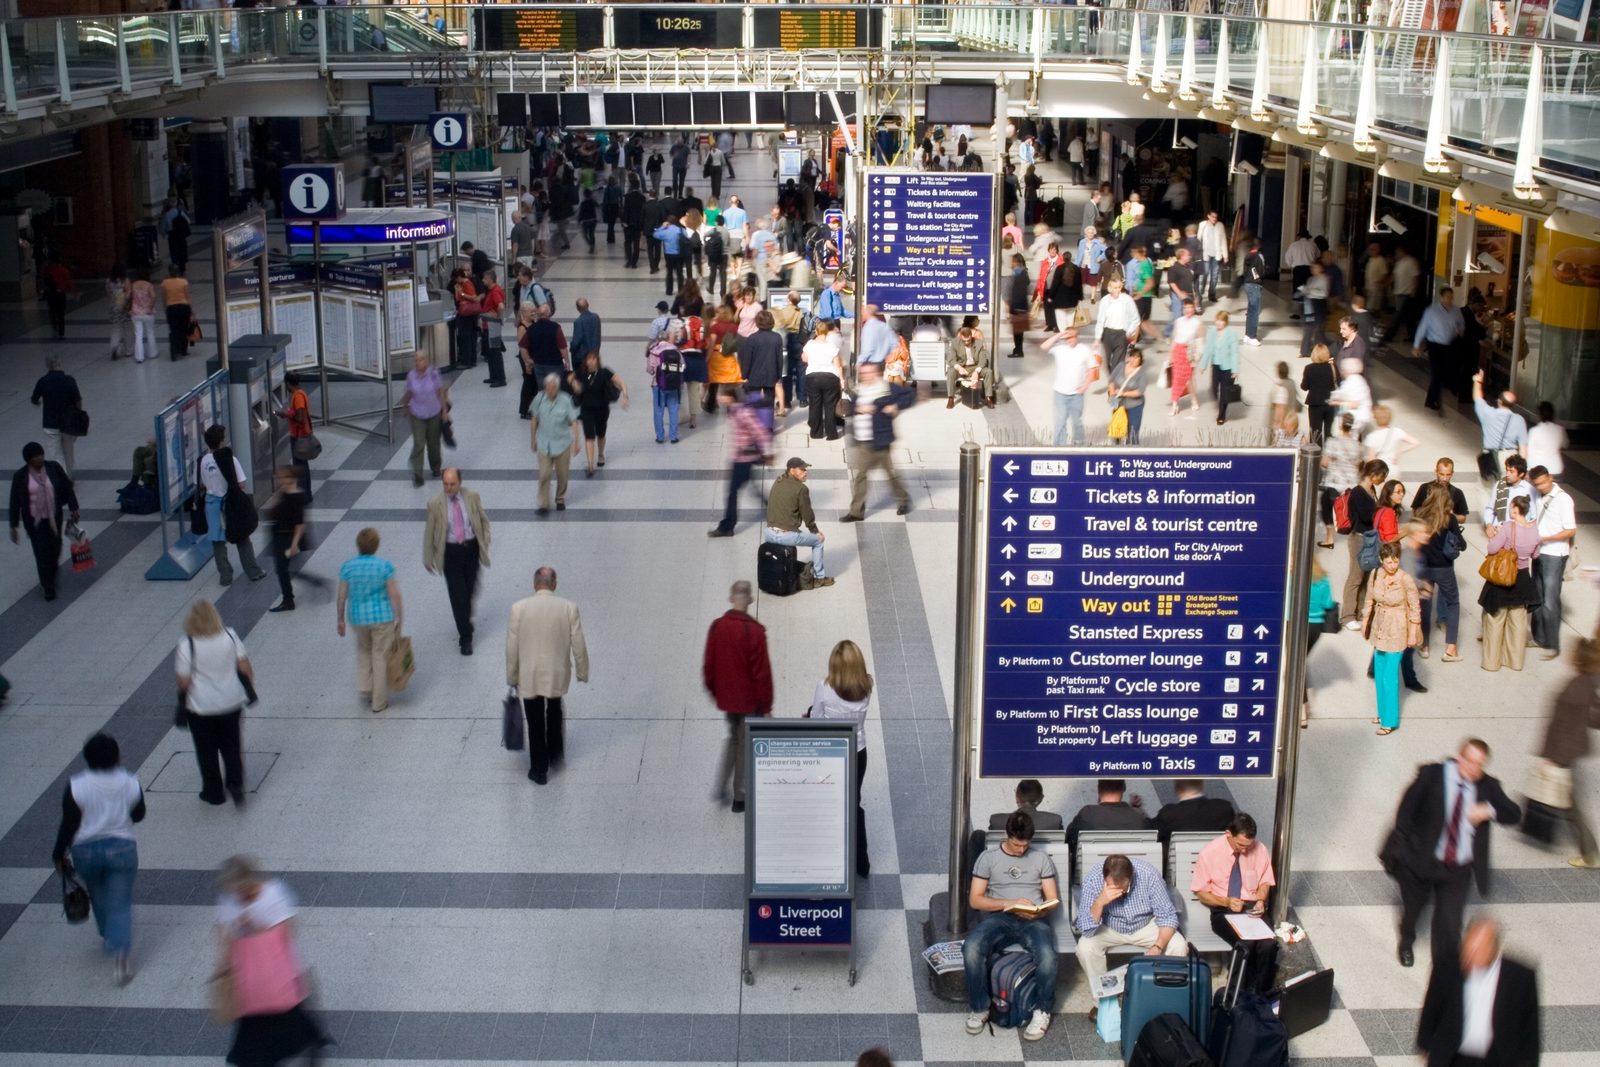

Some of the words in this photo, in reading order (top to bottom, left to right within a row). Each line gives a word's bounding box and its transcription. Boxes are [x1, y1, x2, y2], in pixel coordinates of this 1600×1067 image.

[386, 224, 446, 239] information
[906, 235, 949, 243] Underground
[1086, 461, 1113, 475] Lift
[1120, 459, 1130, 468] To
[1133, 460, 1152, 471] Way
[1154, 461, 1171, 471] out,
[1173, 460, 1232, 472] Underground
[1119, 469, 1135, 477] and
[1138, 469, 1154, 478] Bus
[1156, 470, 1186, 478] station
[1086, 489, 1142, 503] Tickets
[1146, 489, 1159, 503] &
[1164, 490, 1255, 504] information
[1084, 517, 1130, 531] Travel
[1135, 517, 1147, 531] &
[1152, 518, 1203, 531] tourist
[1208, 519, 1257, 531] centre
[1082, 544, 1111, 558] Bus
[1115, 545, 1169, 558] station
[1175, 543, 1190, 551] For
[1192, 543, 1209, 553] City
[1211, 543, 1243, 554] Airport
[1192, 551, 1212, 560] door
[1214, 552, 1221, 560] A
[1082, 571, 1184, 588] Underground
[1082, 599, 1117, 615] Way
[1122, 600, 1150, 612] out
[1069, 625, 1138, 639] Stansted
[1143, 625, 1203, 642] Express
[999, 657, 1010, 667] By
[1013, 657, 1050, 665] Platform
[1052, 657, 1062, 665] 10
[1070, 652, 1146, 665] Customer
[1151, 652, 1202, 668] lounge
[1047, 676, 1058, 686] By
[1061, 676, 1097, 684] Platform
[1100, 676, 1110, 684] 10
[1115, 678, 1157, 695] Cycle
[1162, 680, 1200, 692] store
[1047, 687, 1065, 695] past
[1067, 686, 1084, 694] Taxi
[1086, 686, 1104, 694] rank
[996, 710, 1007, 720] By
[1010, 710, 1047, 718] Platform
[1049, 710, 1059, 718] 10
[1064, 705, 1098, 718] First
[1103, 705, 1142, 718] Class
[1147, 705, 1198, 721] lounge
[1038, 725, 1049, 735] By
[1051, 725, 1088, 733] Platform
[1090, 725, 1100, 733] 10
[1038, 736, 1057, 744] Lost
[1059, 737, 1096, 745] property
[1102, 731, 1133, 744] Left
[1138, 731, 1197, 747] luggage
[1090, 762, 1101, 771] By
[1158, 756, 1195, 769] Taxis
[780, 906, 842, 920] Liverpool
[780, 924, 821, 936] Street
